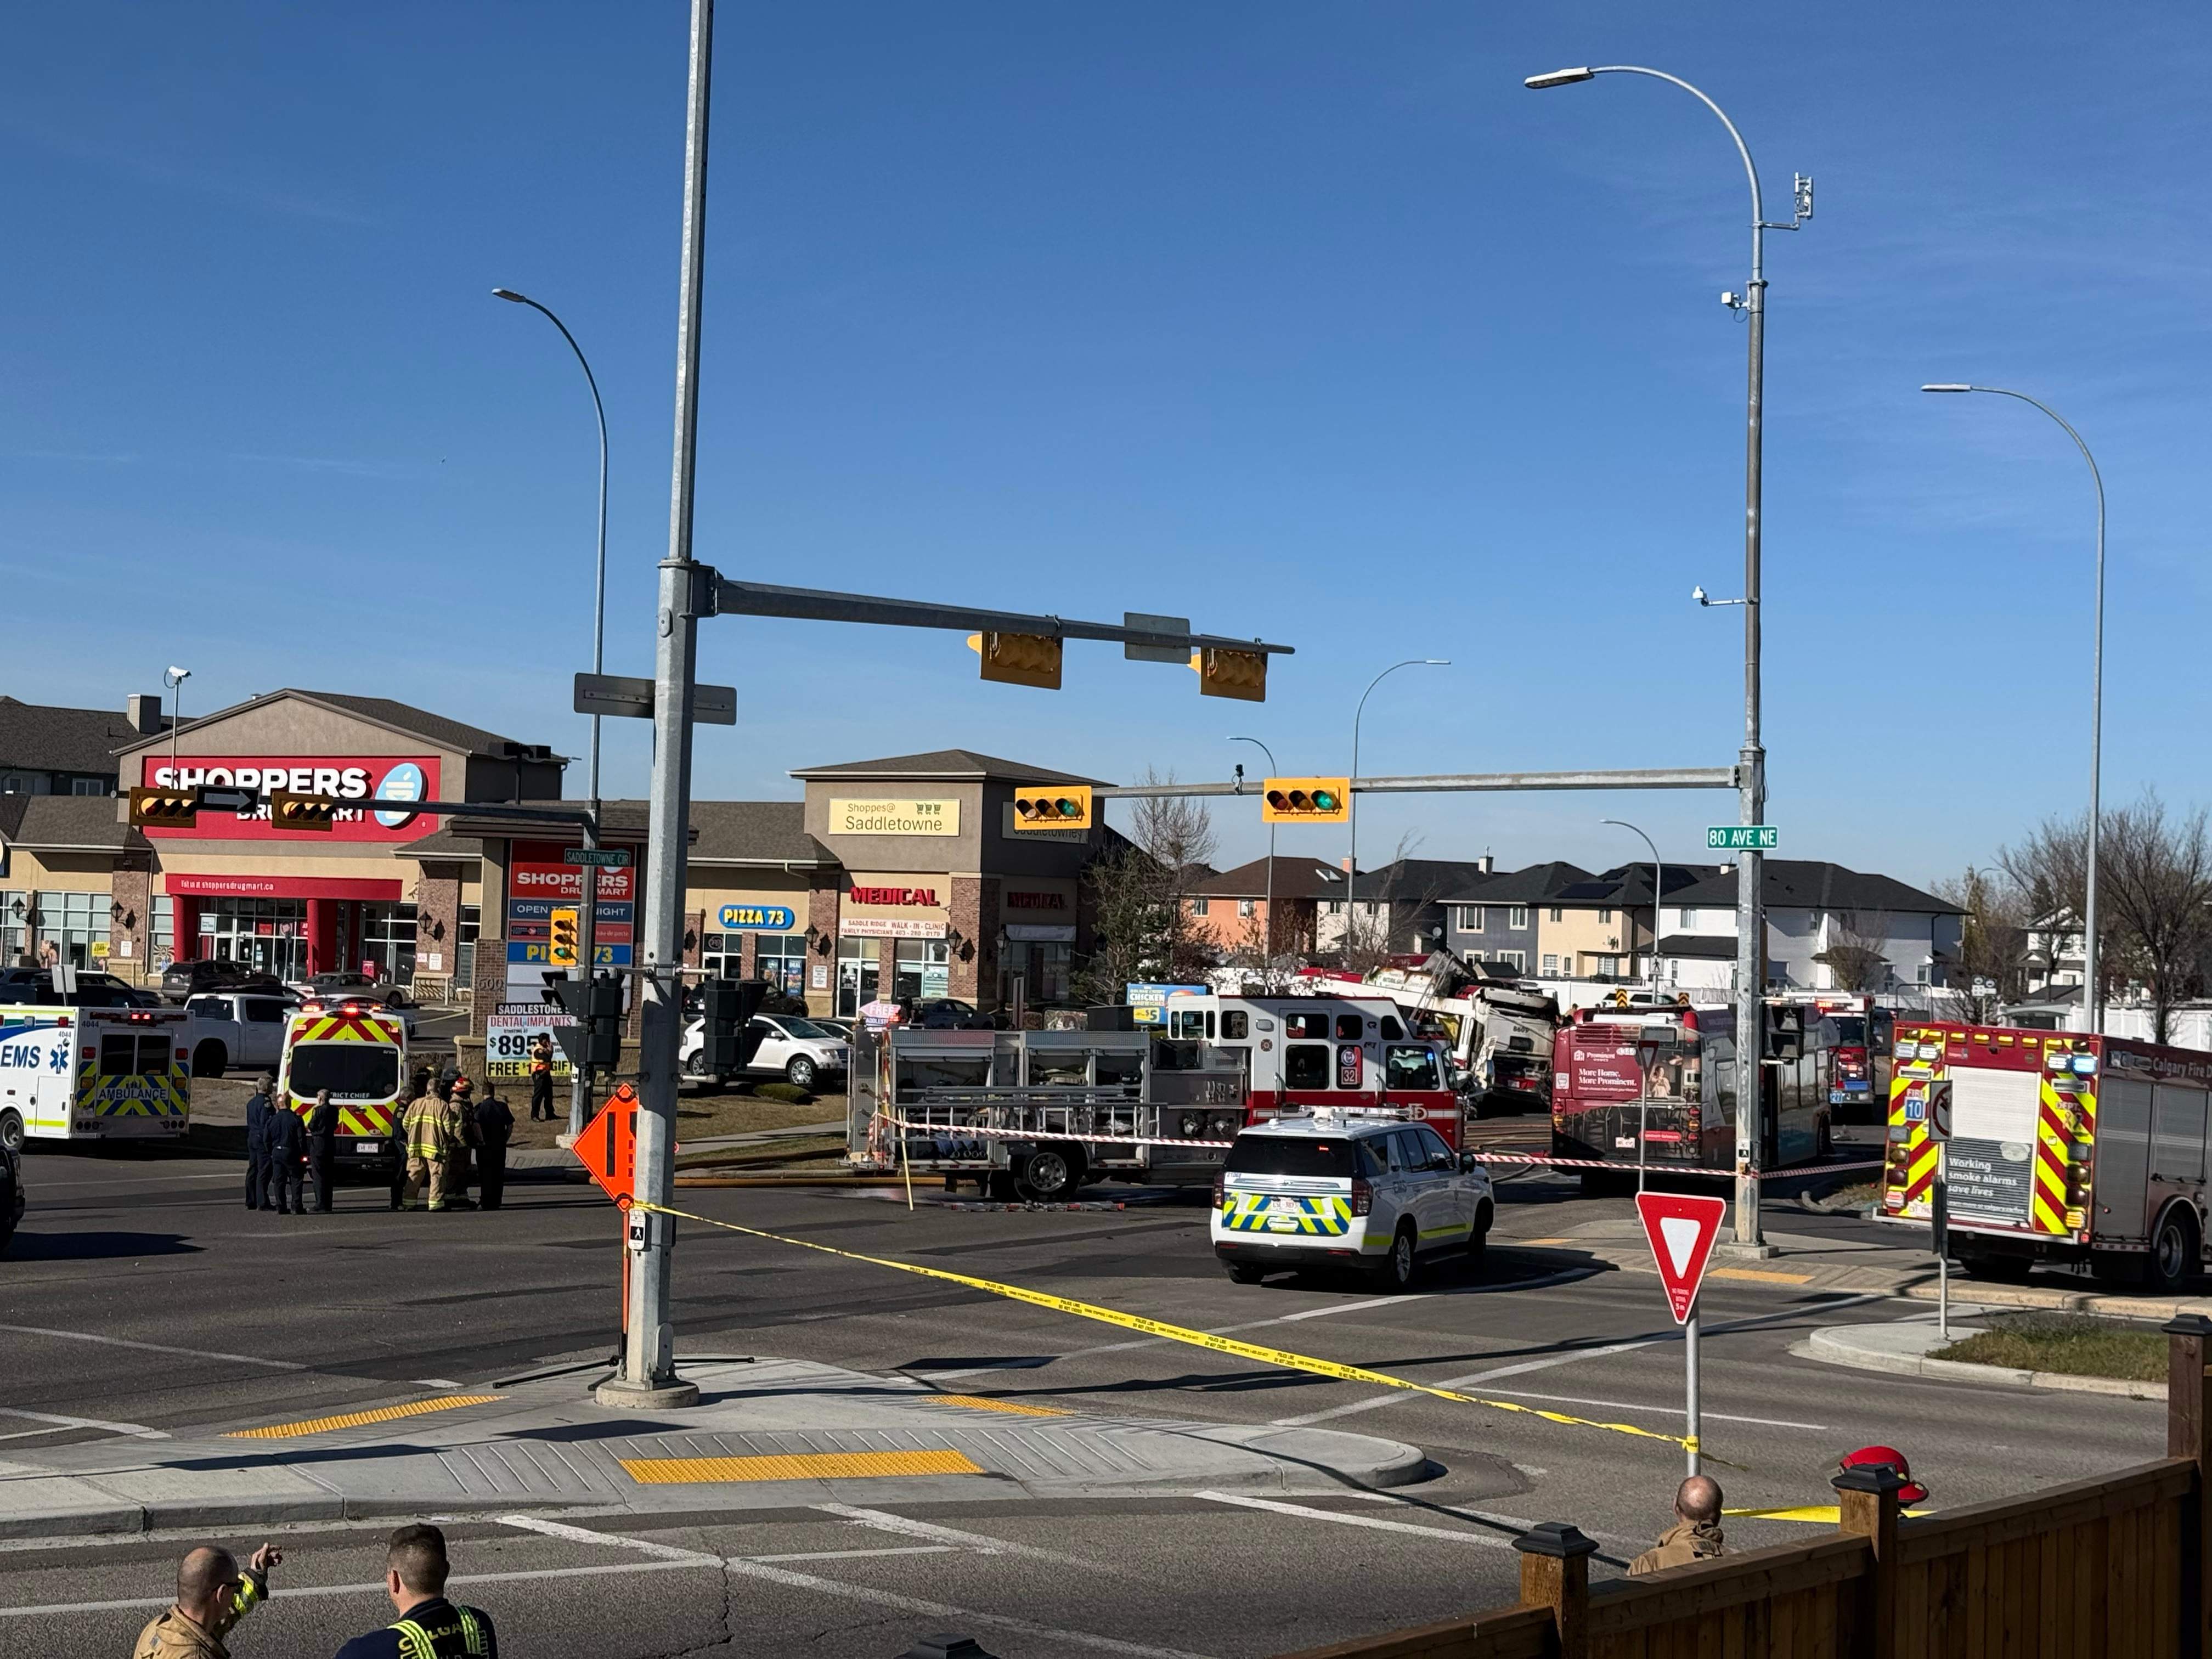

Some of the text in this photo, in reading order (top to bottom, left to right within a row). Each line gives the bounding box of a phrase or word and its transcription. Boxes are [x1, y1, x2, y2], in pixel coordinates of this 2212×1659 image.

[154, 767, 367, 799] SHOPPERS
[845, 816, 943, 831] Saddletowne
[1709, 830, 1776, 846] 80 AVE NE
[566, 851, 629, 865] SADDLETOWNE CIR
[850, 887, 940, 906] MEDICAL
[517, 905, 548, 913] OPEN
[724, 909, 785, 926] PIZZA 73
[498, 1005, 563, 1015] SADDLESTONE
[869, 1005, 894, 1015] FREE
[490, 1016, 572, 1027] DENTAL IMPLANTS
[1, 1045, 41, 1068] EMS
[488, 1061, 520, 1076] FREE
[1578, 1068, 1597, 1077] More
[2153, 1057, 2187, 1077] Calgary
[2188, 1062, 2205, 1077] Fire
[1344, 1070, 1355, 1082] 32
[1578, 1076, 1597, 1085] More
[98, 1088, 167, 1100] AMBULANCE
[1907, 1088, 1926, 1097] FIRE
[1909, 1102, 1922, 1118] 10
[1949, 1157, 1991, 1172] Working
[1949, 1172, 2017, 1186] smoke alarms
[1948, 1185, 1994, 1197] save lives
